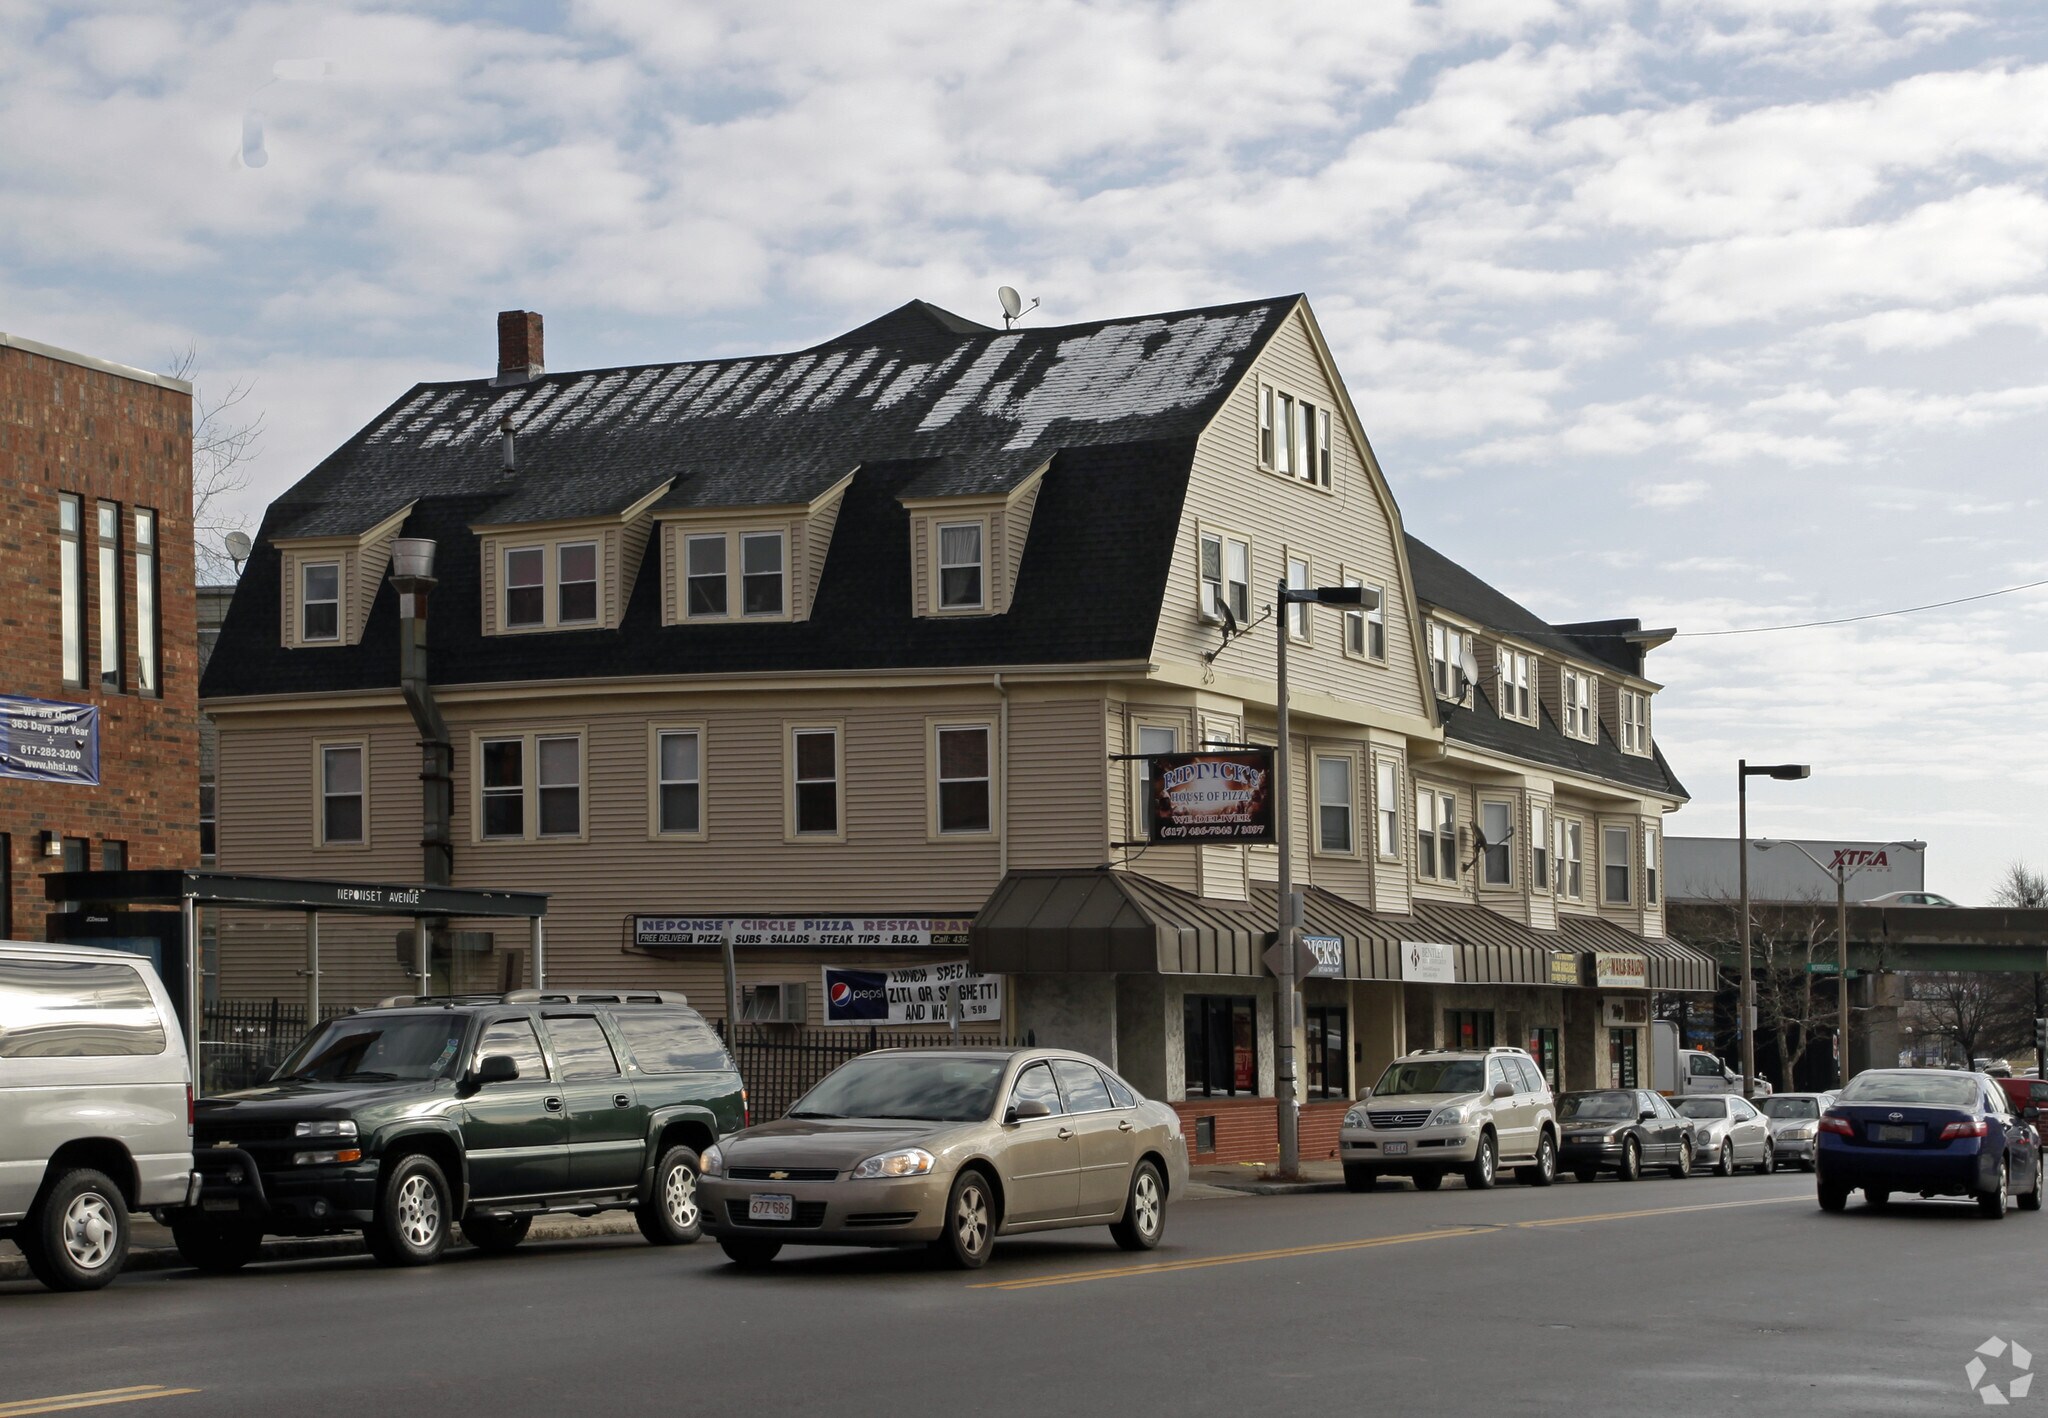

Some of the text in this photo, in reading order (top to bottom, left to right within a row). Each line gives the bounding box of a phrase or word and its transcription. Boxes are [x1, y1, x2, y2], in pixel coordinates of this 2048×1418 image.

[23, 706, 36, 716] We
[55, 711, 78, 721] Open
[11, 719, 89, 736] 363 Days per Year
[20, 745, 81, 760] 617-282-3200
[24, 760, 78, 773] www.hhsi.us
[1163, 762, 1259, 790] RIDDICK'S
[1171, 790, 1251, 802] HOUSE OF PIZZA
[1172, 813, 1251, 824] WE DELIVER
[1827, 848, 1888, 869] XTRA
[337, 888, 419, 904] NEPONSET AVENUE
[740, 920, 796, 932] CIRCLE
[803, 920, 854, 931] PIZZA
[640, 934, 657, 942] FREE
[658, 934, 691, 942] DELIVERY
[735, 934, 762, 943] SUBS
[770, 934, 810, 944] SALADS
[819, 934, 853, 944] STEAK
[857, 934, 881, 944] TIPS
[891, 934, 920, 944] B.B.Q.
[1421, 947, 1444, 959] BENTLEY
[893, 962, 984, 983] LUNCH SPECI
[852, 987, 884, 1001] pepsi
[888, 982, 998, 1003] ZITI OR SGHETTI
[905, 1004, 926, 1021] AND
[931, 1003, 965, 1021] WAR
